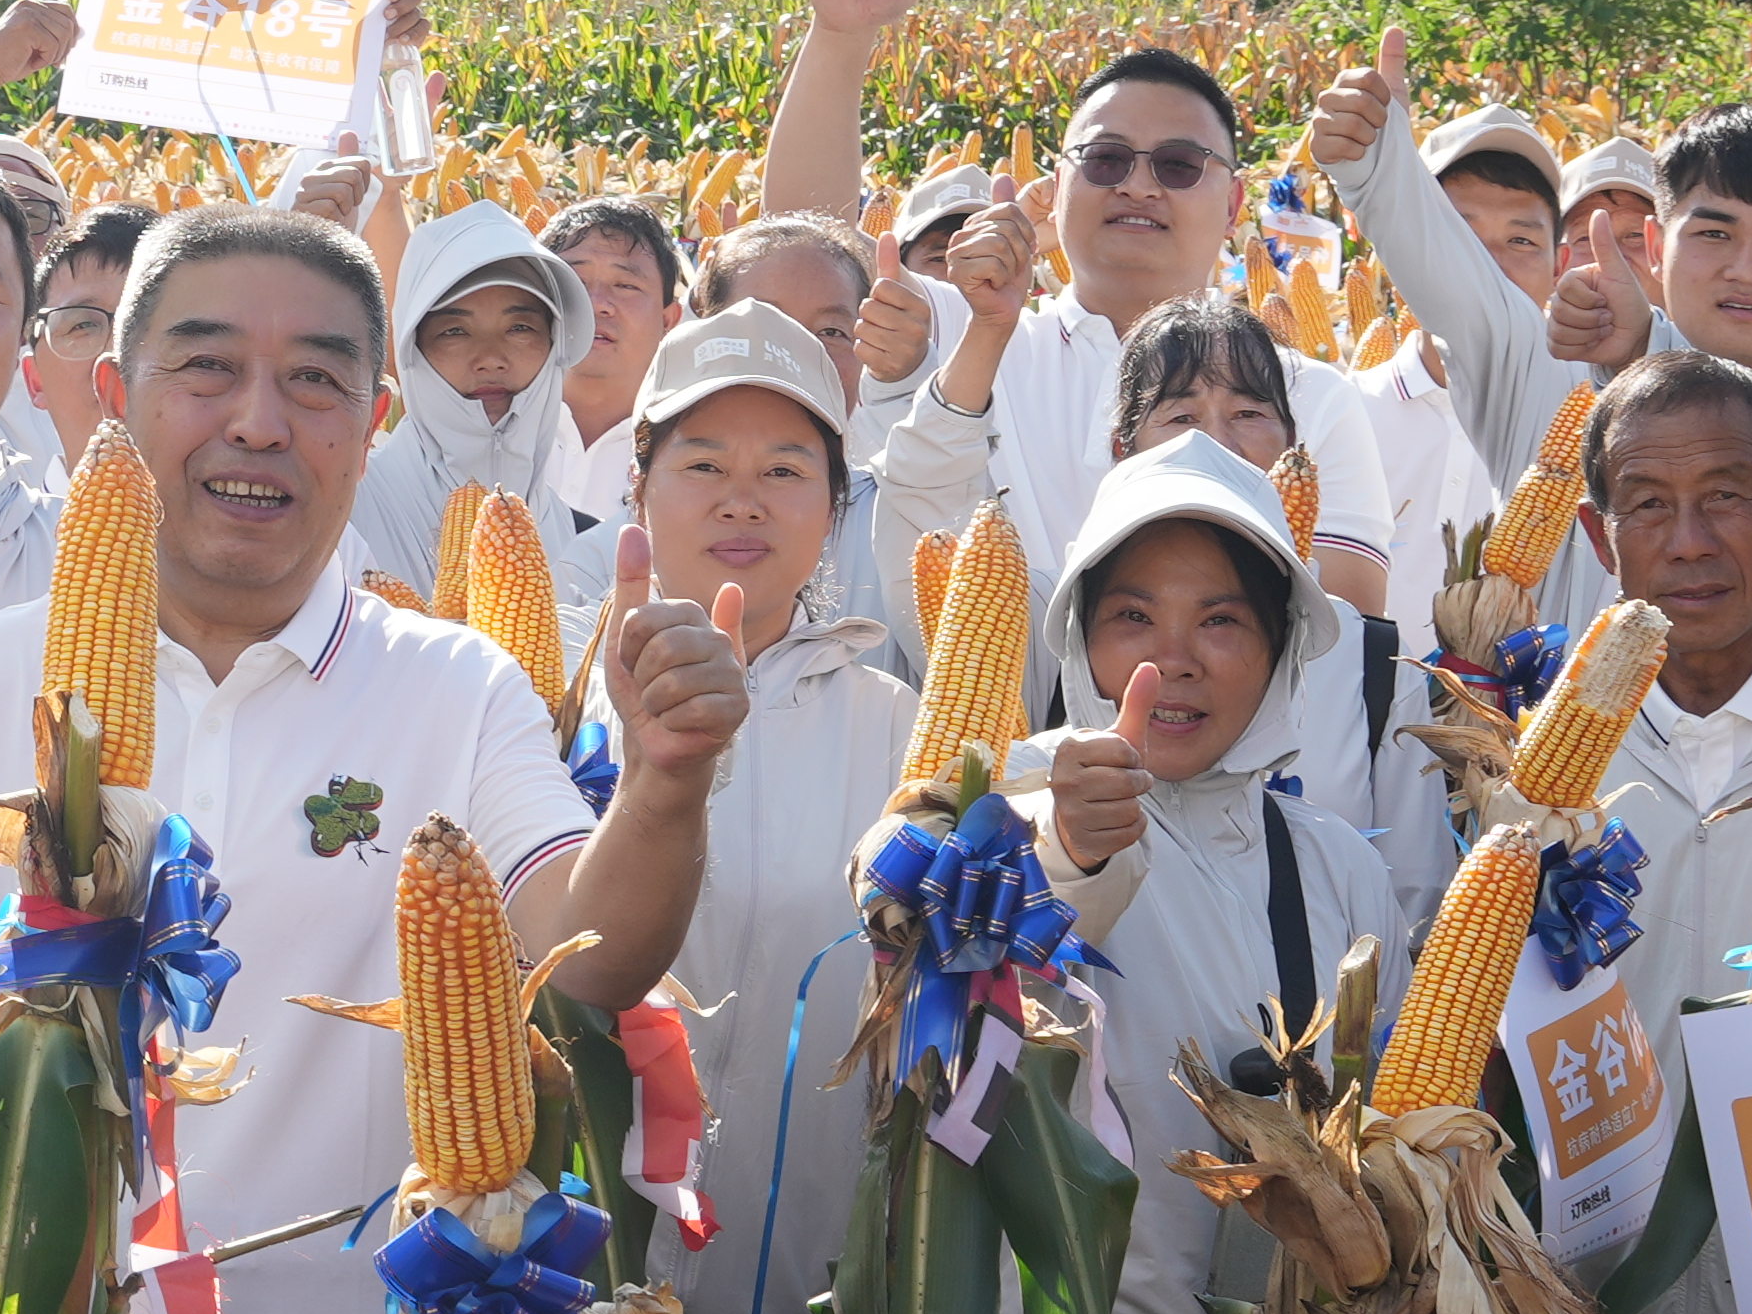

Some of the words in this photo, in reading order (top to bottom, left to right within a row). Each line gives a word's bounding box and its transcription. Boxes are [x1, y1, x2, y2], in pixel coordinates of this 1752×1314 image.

[110, 29, 221, 59] 抗病耐热适应广
[229, 46, 341, 75] 助农丰收有保障
[99, 72, 148, 91] 订购热线
[1570, 1186, 1612, 1221] 订购热线
